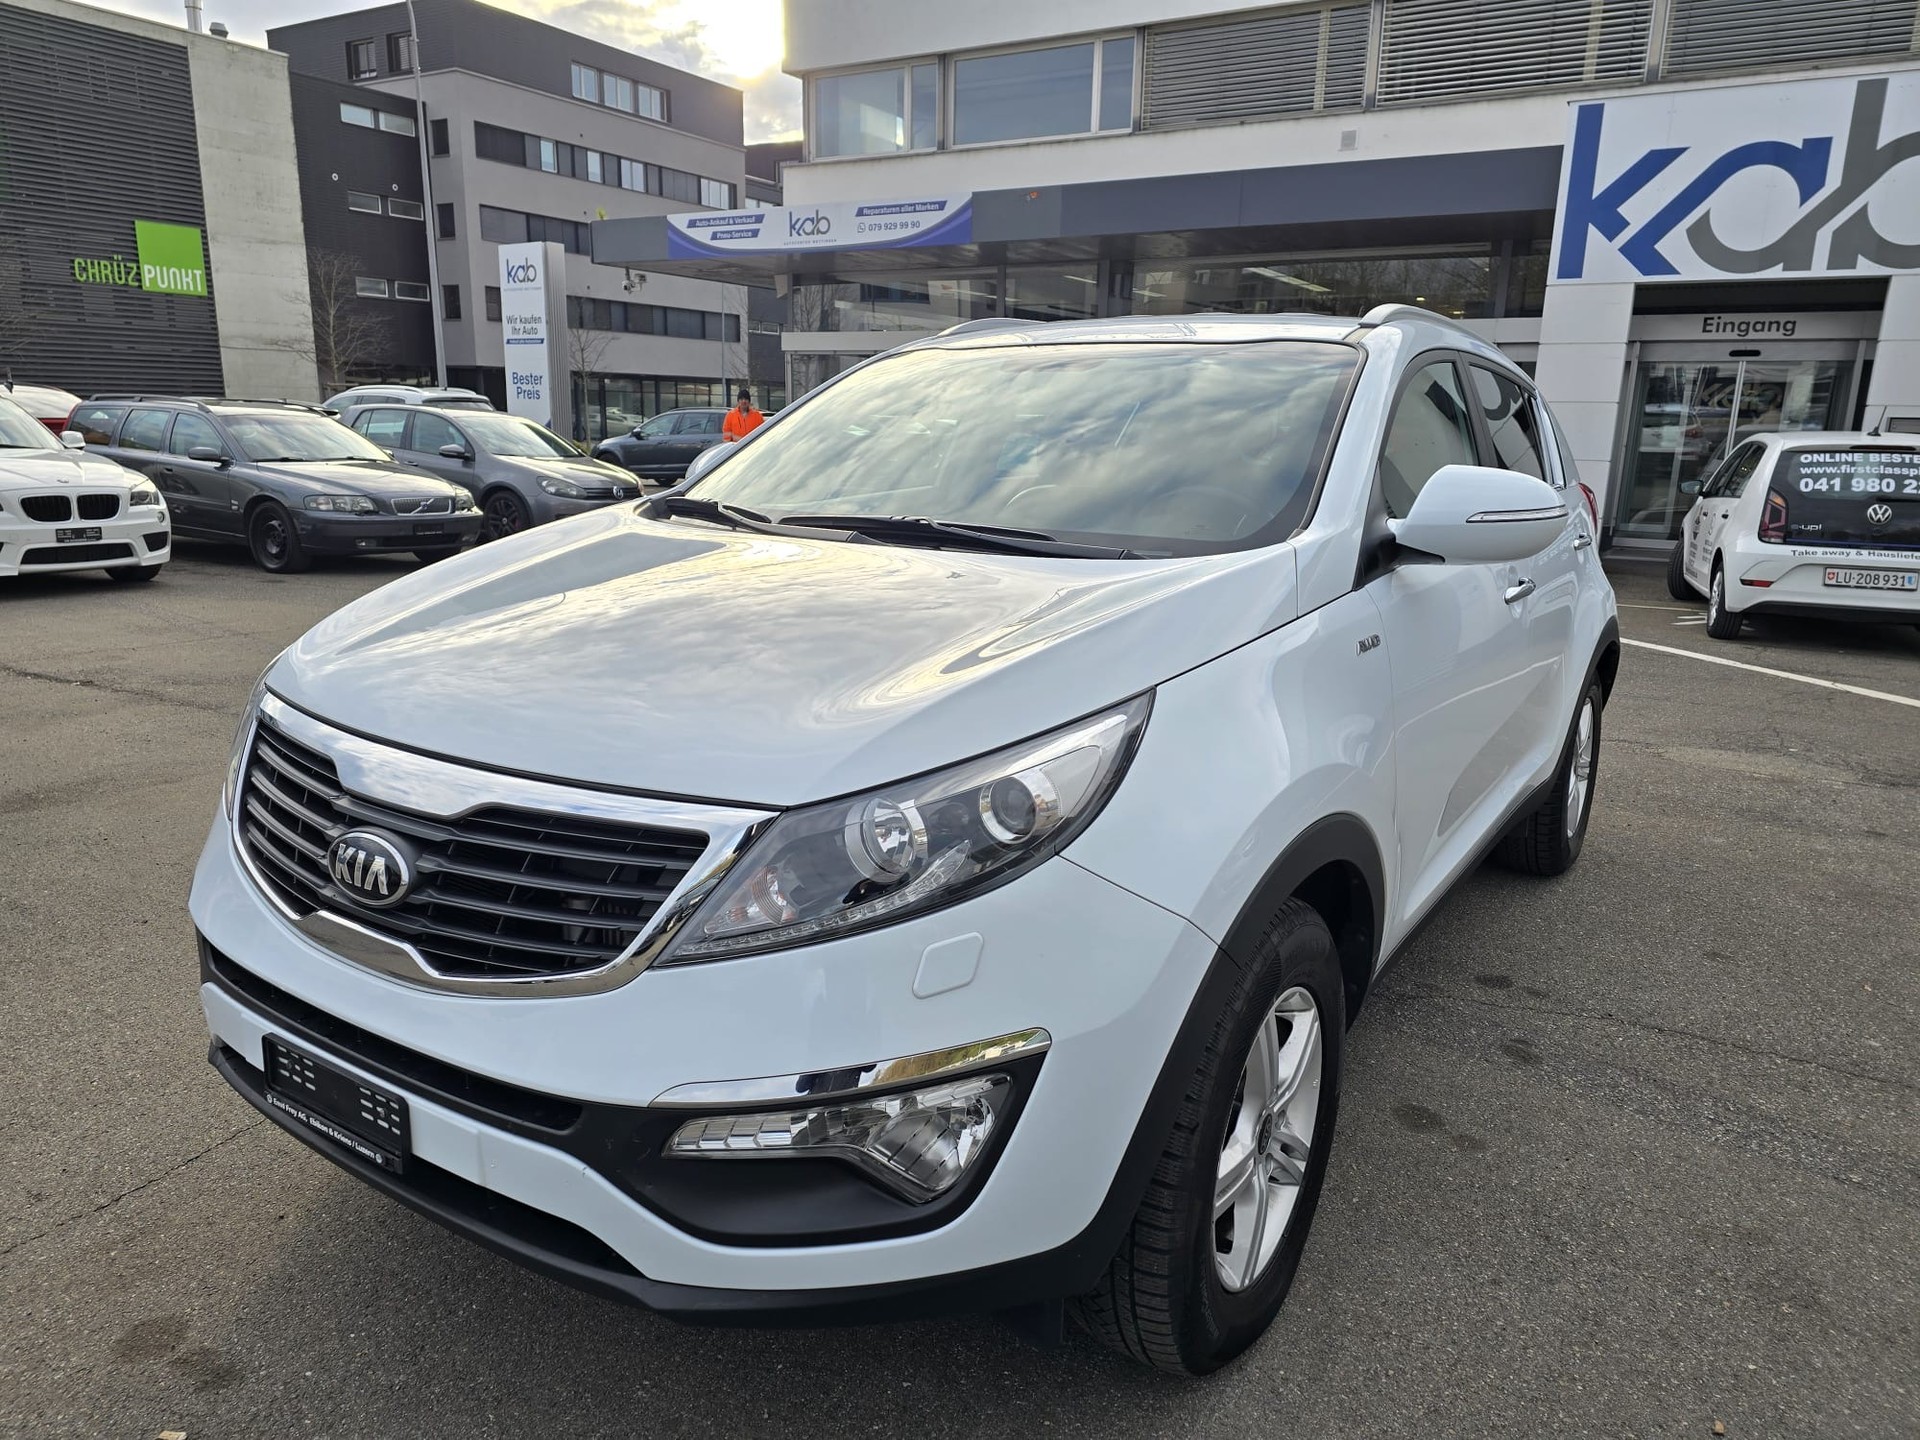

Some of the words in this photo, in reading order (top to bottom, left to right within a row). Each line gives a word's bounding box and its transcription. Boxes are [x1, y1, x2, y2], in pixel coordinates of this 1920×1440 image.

[863, 205, 900, 215] Reparaturen
[901, 204, 915, 212] aller
[916, 202, 939, 211] Marken
[735, 215, 755, 223] Verkauf
[789, 209, 831, 237] kab
[883, 222, 898, 230] 929
[899, 221, 909, 229] 99
[910, 221, 921, 229] 90
[716, 230, 752, 238] Pneu-Service
[74, 254, 139, 287] CHRÜZ
[143, 264, 202, 293] PUNKT
[506, 257, 537, 284] kab
[506, 315, 518, 325] Wir
[519, 314, 542, 325] kaufen
[1702, 315, 1797, 338] Eingang
[511, 327, 521, 336] Ihr
[522, 326, 538, 336] Auto
[512, 372, 543, 386] Bester
[516, 386, 541, 400] Preis
[1800, 453, 1863, 464] ONLINE
[1800, 477, 1841, 492] 041
[1850, 477, 1896, 493] 980
[336, 843, 388, 895] KIA
[285, 1104, 298, 1118] Frey
